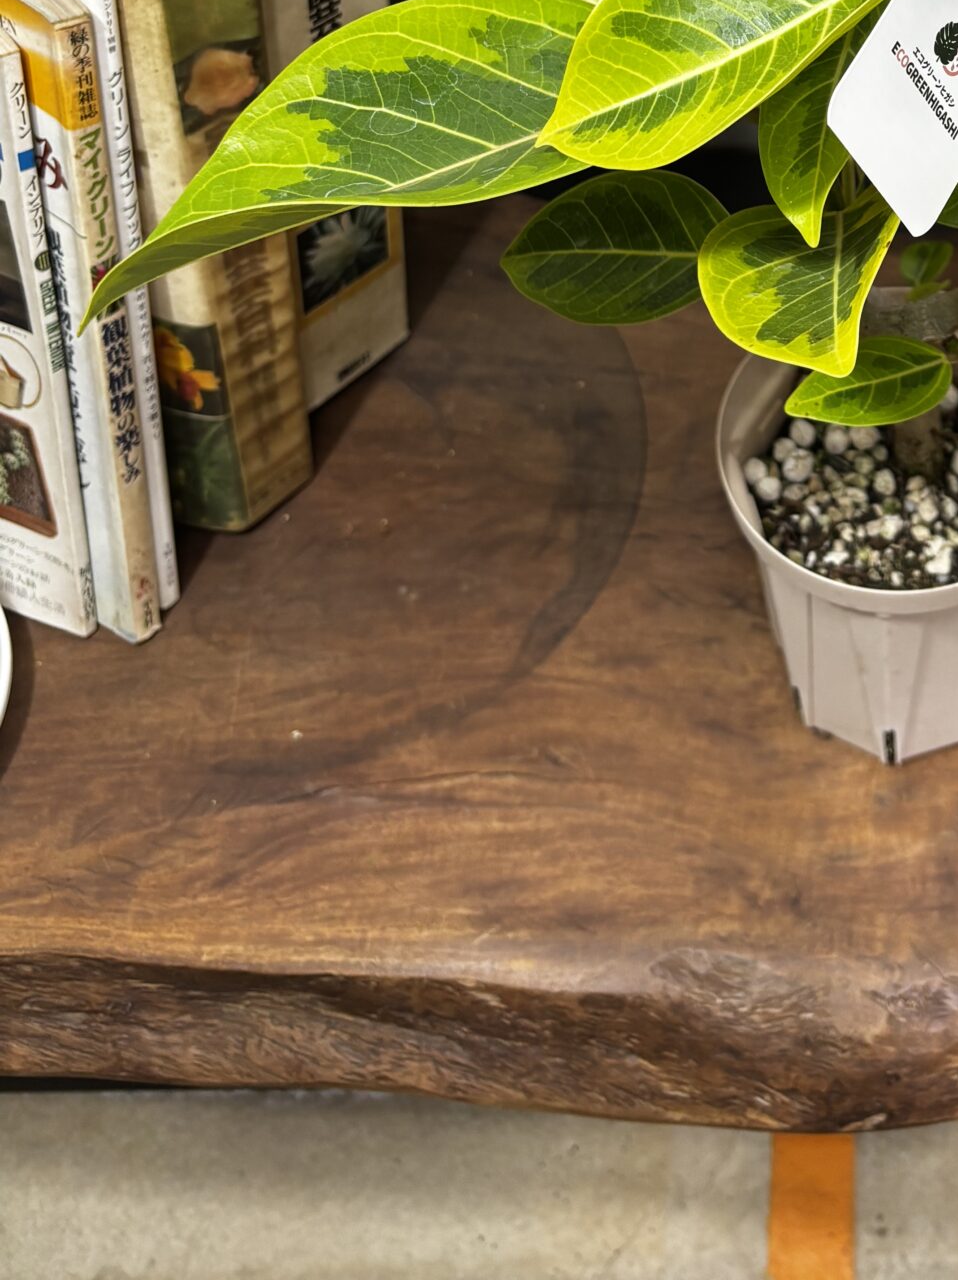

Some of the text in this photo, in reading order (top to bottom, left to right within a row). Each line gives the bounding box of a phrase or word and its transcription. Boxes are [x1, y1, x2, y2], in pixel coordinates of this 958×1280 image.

[68, 28, 99, 121] 緑の季刊雑誌
[912, 46, 956, 108] エコグリーンヒガシ
